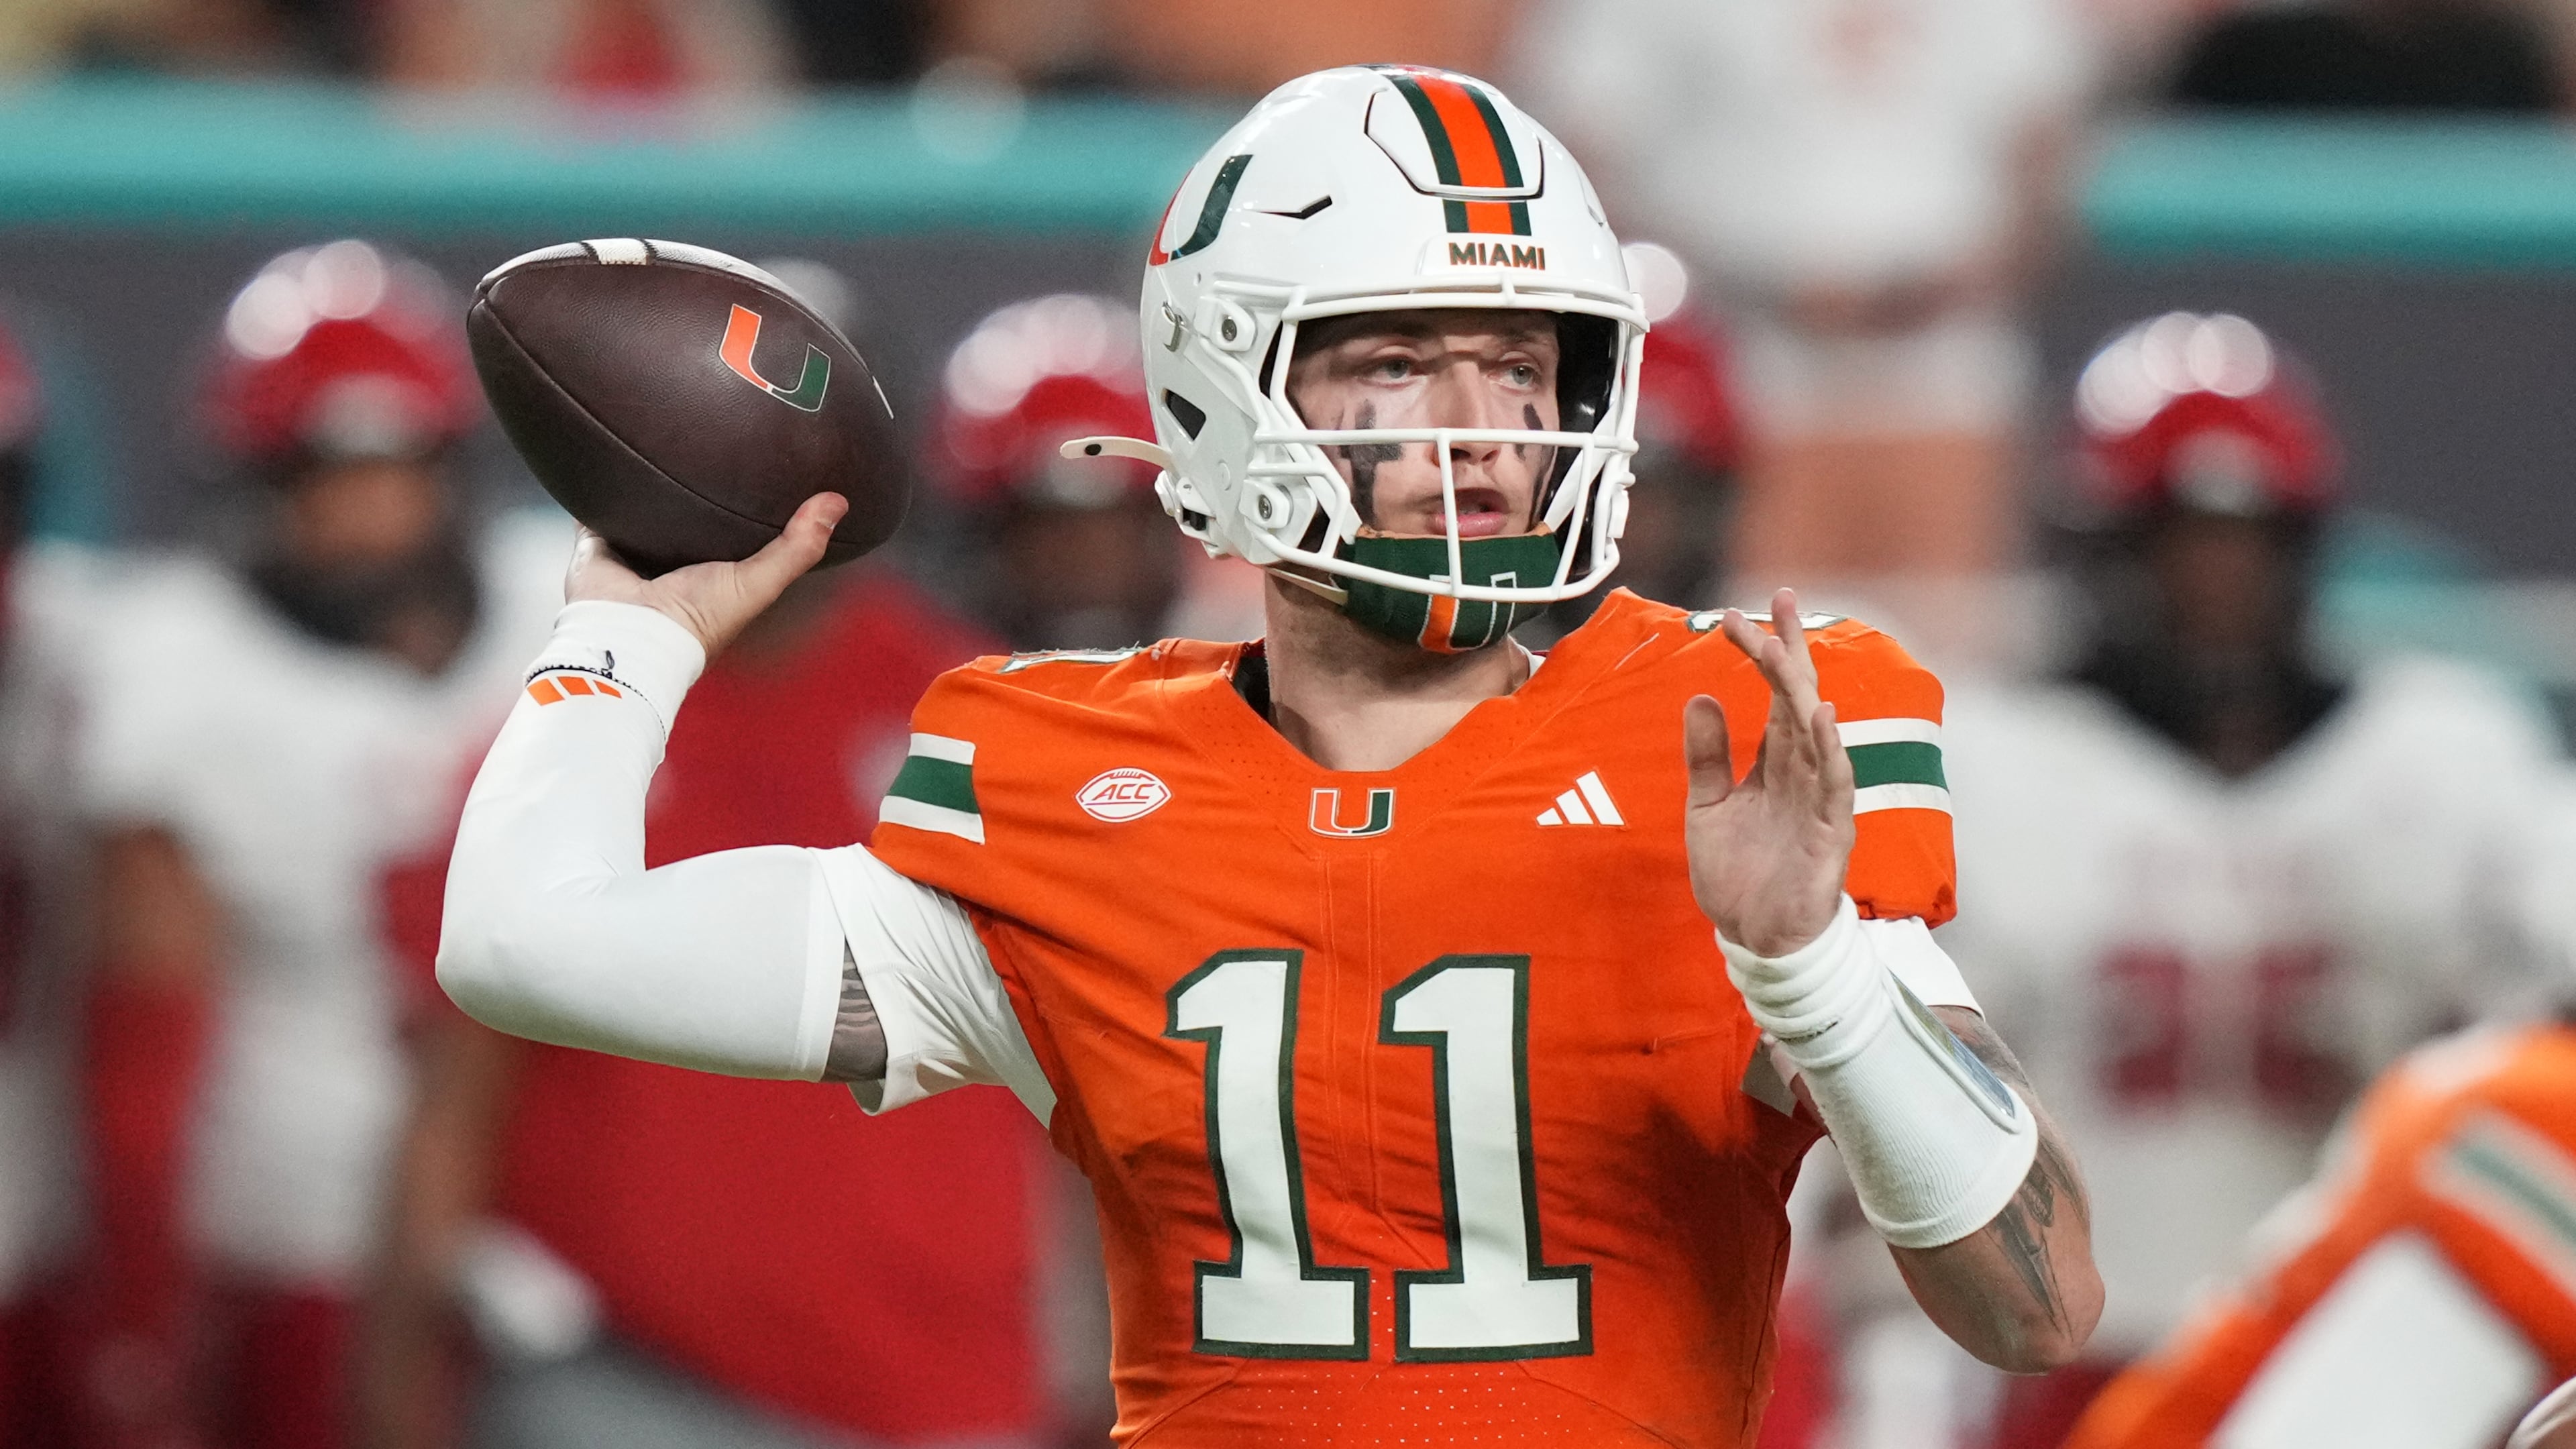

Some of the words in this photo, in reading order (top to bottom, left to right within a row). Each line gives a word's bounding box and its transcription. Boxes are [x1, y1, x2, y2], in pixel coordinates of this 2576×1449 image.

[1448, 241, 1546, 271] MIAMI
[719, 303, 832, 412] U
[1091, 784, 1156, 800] ACC
[1309, 788, 1395, 838] U
[1161, 948, 1594, 1363] 11
